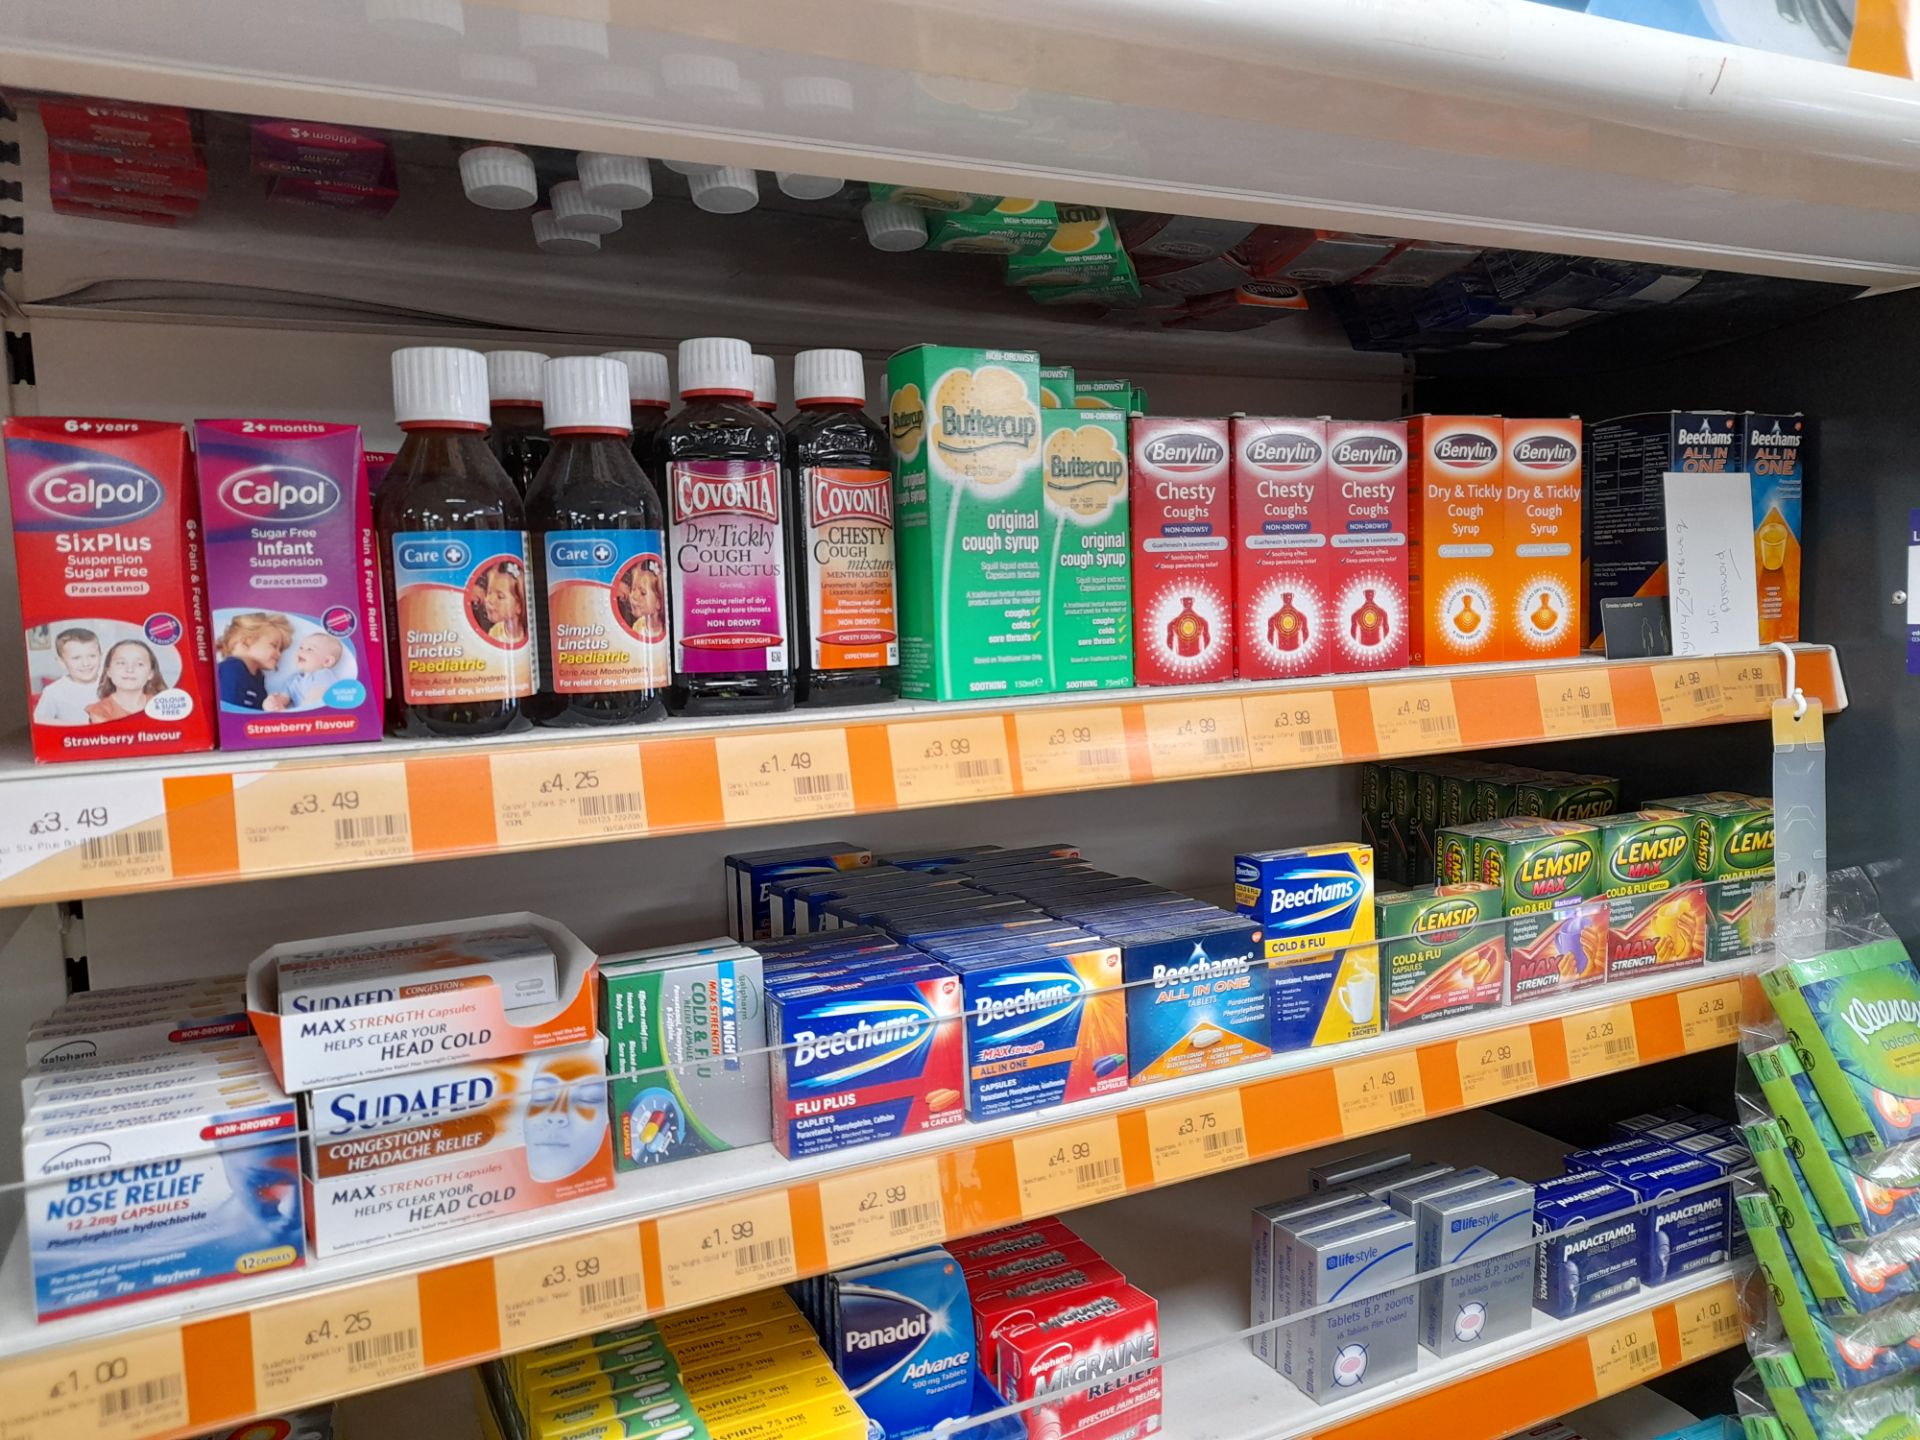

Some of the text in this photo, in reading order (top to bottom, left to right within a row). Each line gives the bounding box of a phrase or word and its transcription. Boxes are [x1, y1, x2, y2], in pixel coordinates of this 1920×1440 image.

[64, 421, 139, 434] 6+ years
[242, 421, 325, 433] 2+ months
[942, 406, 1036, 439] Buttercup
[1678, 428, 1733, 446] Beechams
[1152, 443, 1217, 465] Benylin
[1253, 442, 1316, 464] Benylin
[1682, 447, 1728, 459] ALL IN
[1051, 455, 1123, 478] Buttercup
[1754, 460, 1796, 476] ONE
[44, 478, 144, 509] Calpol
[232, 480, 325, 509] Calpol
[678, 475, 774, 515] COVONIA
[816, 479, 891, 518] COVONIA
[1155, 482, 1216, 504] Chesty
[1256, 481, 1315, 503] Chesty
[1428, 484, 1502, 503] Dry & Tickly
[1507, 485, 1581, 503] Dry & Tickly
[987, 511, 1039, 533] original
[1163, 504, 1209, 520] Coughs
[1447, 504, 1484, 521] Cough
[251, 527, 317, 540] Sugar Free
[1164, 525, 1208, 534] NON-DROWSY
[1451, 523, 1480, 537] Syrup
[56, 534, 152, 552] SixPlus
[257, 541, 314, 556] Infant
[962, 534, 1039, 554] cough syrup
[1081, 532, 1126, 551] original
[67, 555, 143, 568] Suspension
[404, 549, 439, 562] Care
[1061, 552, 1126, 568] cough syrup
[709, 564, 780, 577] LINCTUS
[827, 571, 889, 579] MENTHOLATED
[255, 576, 323, 587] Paracetamol
[706, 618, 761, 628] NON DROWSY
[407, 630, 457, 645] Simple
[408, 645, 463, 657] Linctus
[408, 659, 486, 672] Paediatric
[1736, 667, 1764, 683] £4.99
[1674, 670, 1701, 690] £4.99
[1561, 685, 1592, 702] £4.49
[1397, 698, 1431, 716] £4.49
[1274, 710, 1311, 729] £3.99
[63, 730, 182, 748] Strawberry flavour
[1048, 727, 1092, 747] £3.99
[925, 738, 970, 759] £3.99
[759, 752, 812, 774] £1.49
[539, 770, 600, 793] £4.25
[290, 790, 360, 815] £3.49
[30, 806, 108, 835] £3.49
[1616, 835, 1687, 866] LEMSIP
[1699, 821, 1711, 872] LEMSIP
[1521, 851, 1592, 883] LEMSIP
[1628, 861, 1664, 879] MAX
[1270, 879, 1355, 914] Beechams
[1532, 876, 1568, 897] MAX
[1417, 907, 1478, 932] LEMSIP
[1271, 937, 1327, 953] COLD & FLU
[1616, 935, 1660, 960] MAX
[1392, 949, 1442, 967] COLD & FLU
[1519, 955, 1565, 978] MAX
[1611, 955, 1657, 971] STRENGTH
[1516, 974, 1561, 993] STRENGTH
[974, 981, 1072, 1027] Beechams
[1698, 998, 1725, 1016] £3.29
[300, 1002, 477, 1039] MAX STRENGTH Capsules
[708, 980, 720, 1056] MAX STRENGTH
[323, 1022, 448, 1053] HELPS CLEAR YOUR
[793, 1012, 920, 1068] Beechams
[1351, 1027, 1379, 1038] SACHETS
[1585, 1022, 1615, 1042] £3.29
[380, 1029, 492, 1062] HEAD COLD
[1480, 1046, 1513, 1067] £2.99
[980, 1060, 1028, 1076] ALL IN ONE
[979, 1078, 1018, 1093] CAPSULES
[1362, 1070, 1396, 1094] £1.49
[329, 1077, 493, 1134] SUDAFED
[795, 1094, 857, 1116] FLU PLUS
[796, 1115, 835, 1130] CAPLETS
[1178, 1112, 1217, 1136] £3.75
[347, 1132, 484, 1172] HEADACHE RELIEF
[1048, 1141, 1091, 1167] £4.99
[66, 1159, 182, 1194] BLOCKED
[47, 1173, 205, 1221] NOSE RELIEF
[408, 1186, 517, 1223] HEAD COLD
[858, 1185, 907, 1212] £2.99
[66, 1199, 191, 1232] 12.2mg CAPSULES
[1460, 1211, 1500, 1230] lifestyle
[1655, 1196, 1723, 1233] PARACETAMOL
[47, 1210, 207, 1249] Phenylephrine hydrochloride
[701, 1220, 755, 1250] £1.99
[1564, 1222, 1637, 1263] PARACETAMOL
[242, 1252, 291, 1270] 12 CAPSULES
[1337, 1247, 1379, 1268] lifestyle
[152, 1266, 202, 1285] Hayfever
[541, 1256, 601, 1289] £3.99
[116, 1281, 136, 1294] Flu
[1039, 1297, 1117, 1334] MIGRAINE
[1327, 1294, 1415, 1330] Tablets B.P. 200mg
[1695, 1301, 1722, 1324] £1.00
[304, 1309, 373, 1346] £4.25
[845, 1314, 927, 1353] Panadol
[1610, 1331, 1638, 1356] £1.00
[901, 1350, 971, 1384] Advance
[1030, 1353, 1074, 1377] galpharm
[1032, 1332, 1156, 1412] MIGRAINE
[50, 1356, 128, 1399] £1.00
[911, 1369, 968, 1390] 500 mg Tablets
[697, 1393, 748, 1414] ASPIRIN
[1077, 1389, 1160, 1428] EFFECTIVE PAIN RELIEF
[648, 1418, 662, 1429] 12
